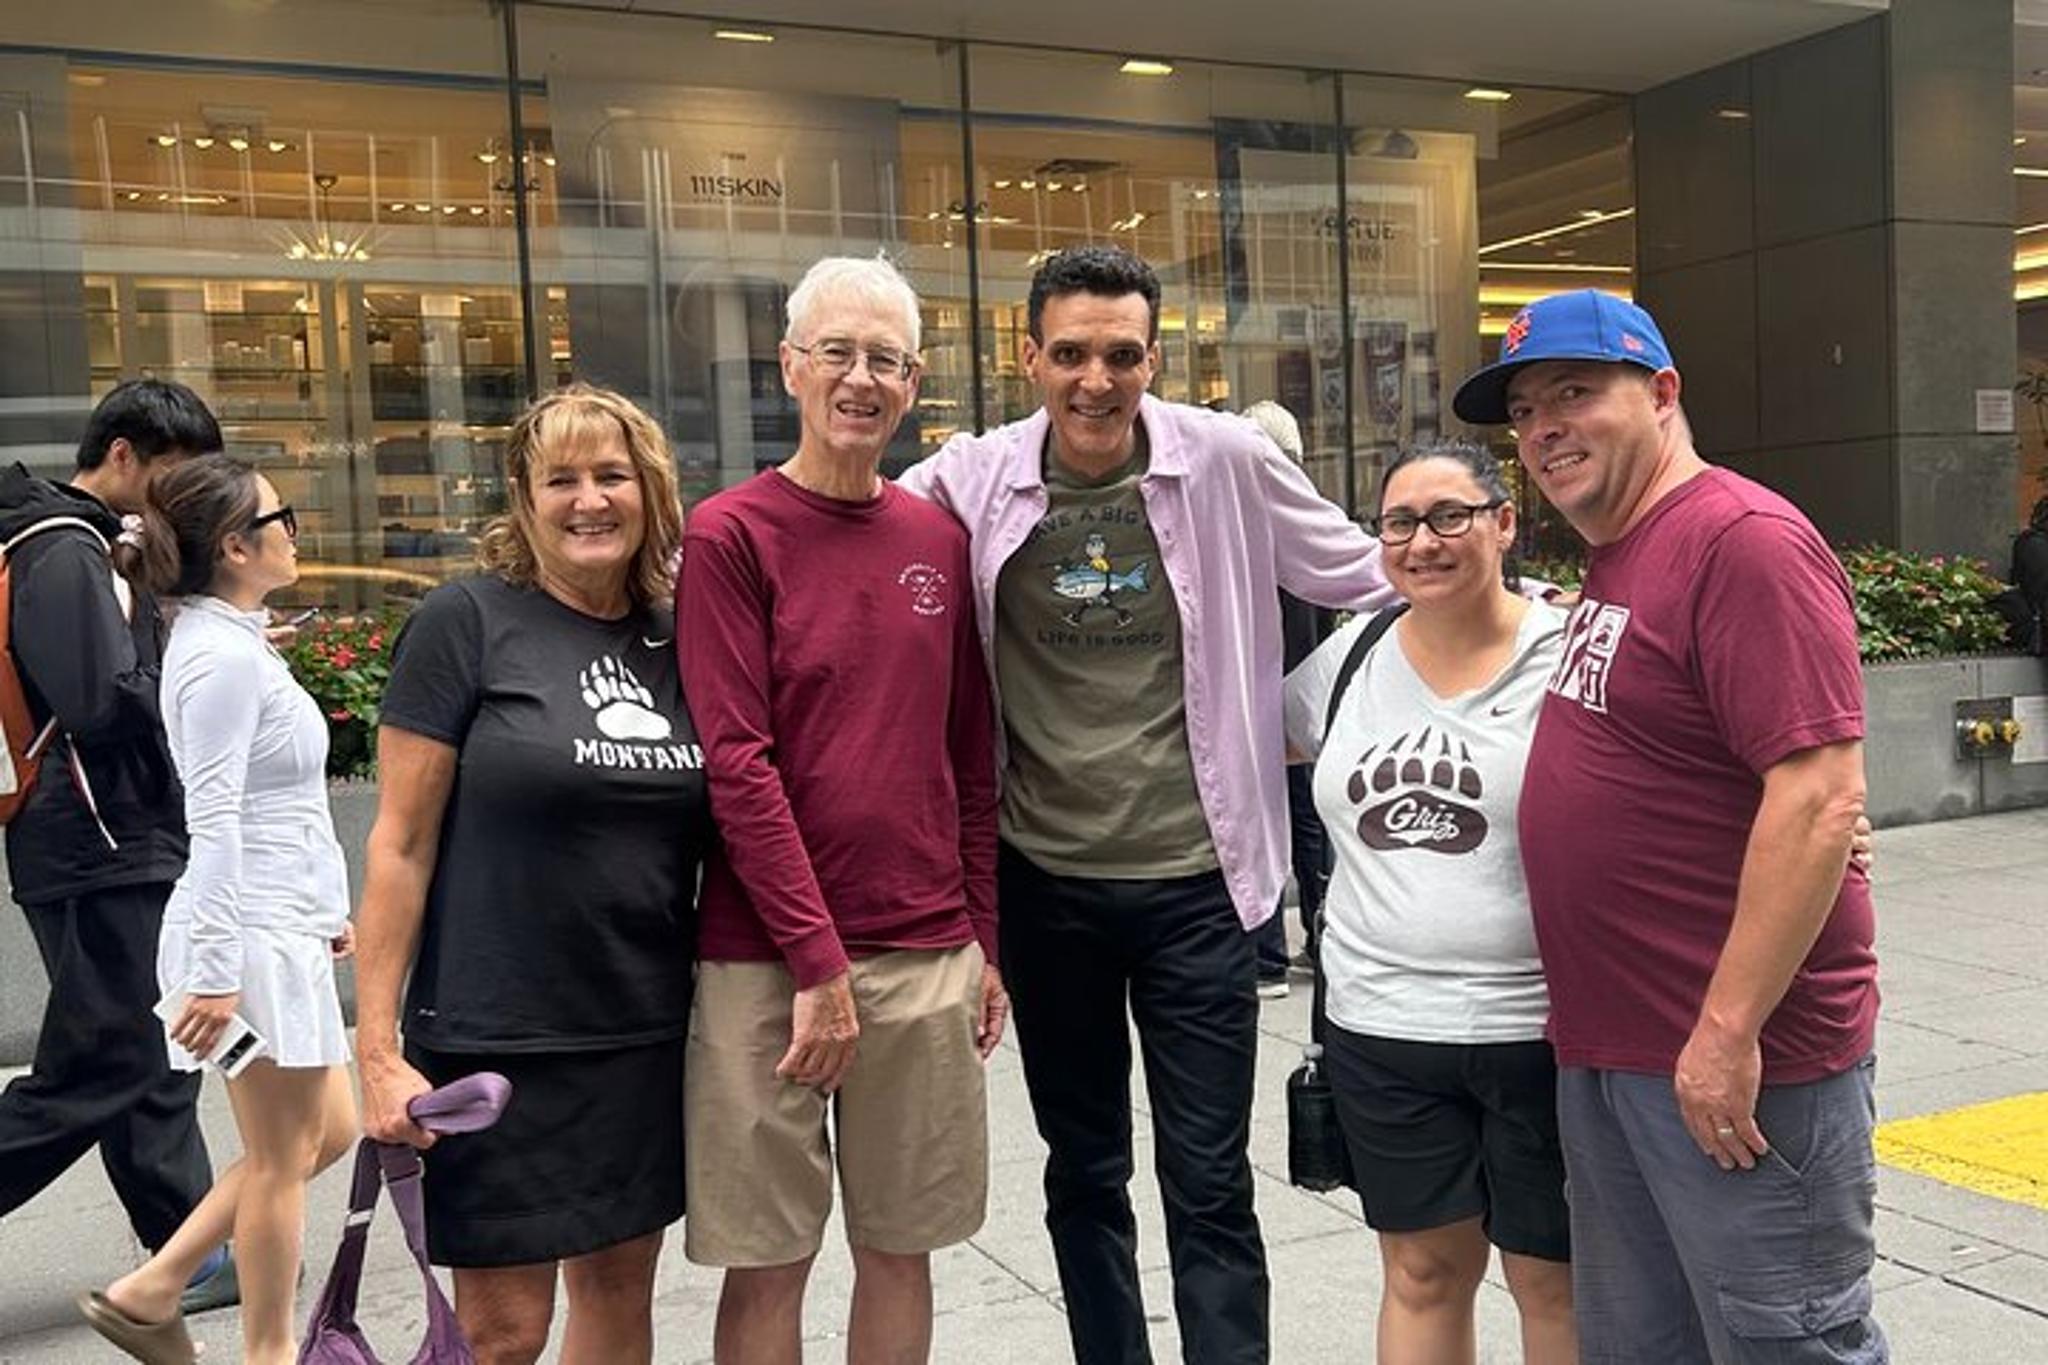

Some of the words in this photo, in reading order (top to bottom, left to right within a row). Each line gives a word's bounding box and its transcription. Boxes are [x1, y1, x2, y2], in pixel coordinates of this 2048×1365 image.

[690, 175, 782, 197] 111SKIN
[1080, 507, 1095, 523] A
[1101, 505, 1139, 524] BIG
[1111, 630, 1164, 646] GOOD
